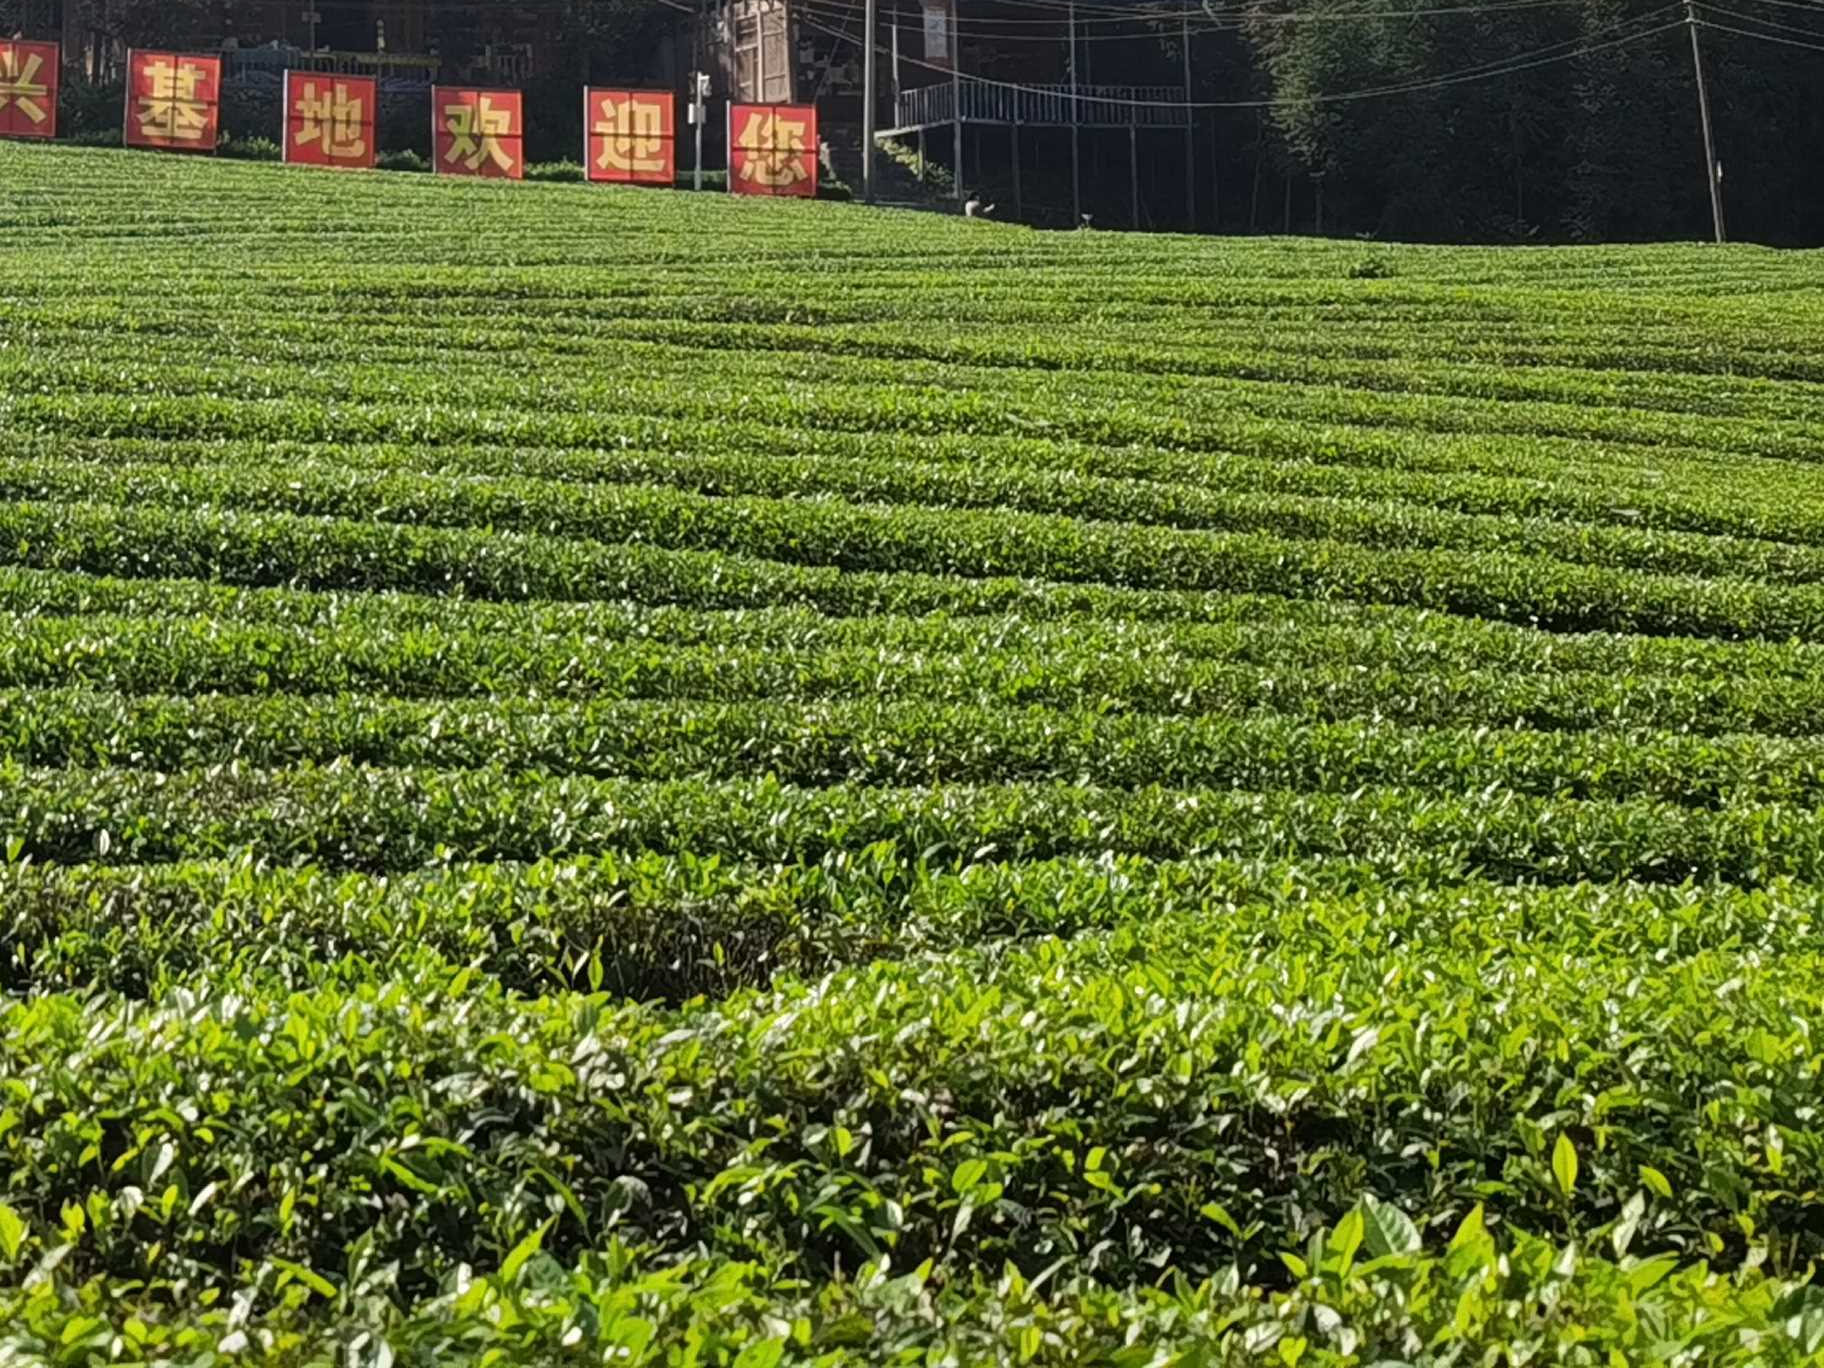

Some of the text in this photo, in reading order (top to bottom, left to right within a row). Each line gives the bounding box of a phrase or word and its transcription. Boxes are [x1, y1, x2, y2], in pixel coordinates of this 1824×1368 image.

[137, 61, 208, 140] 基
[294, 82, 365, 159] 地
[444, 96, 515, 173] 欢
[595, 98, 666, 172] 迎
[737, 112, 808, 188] 您
